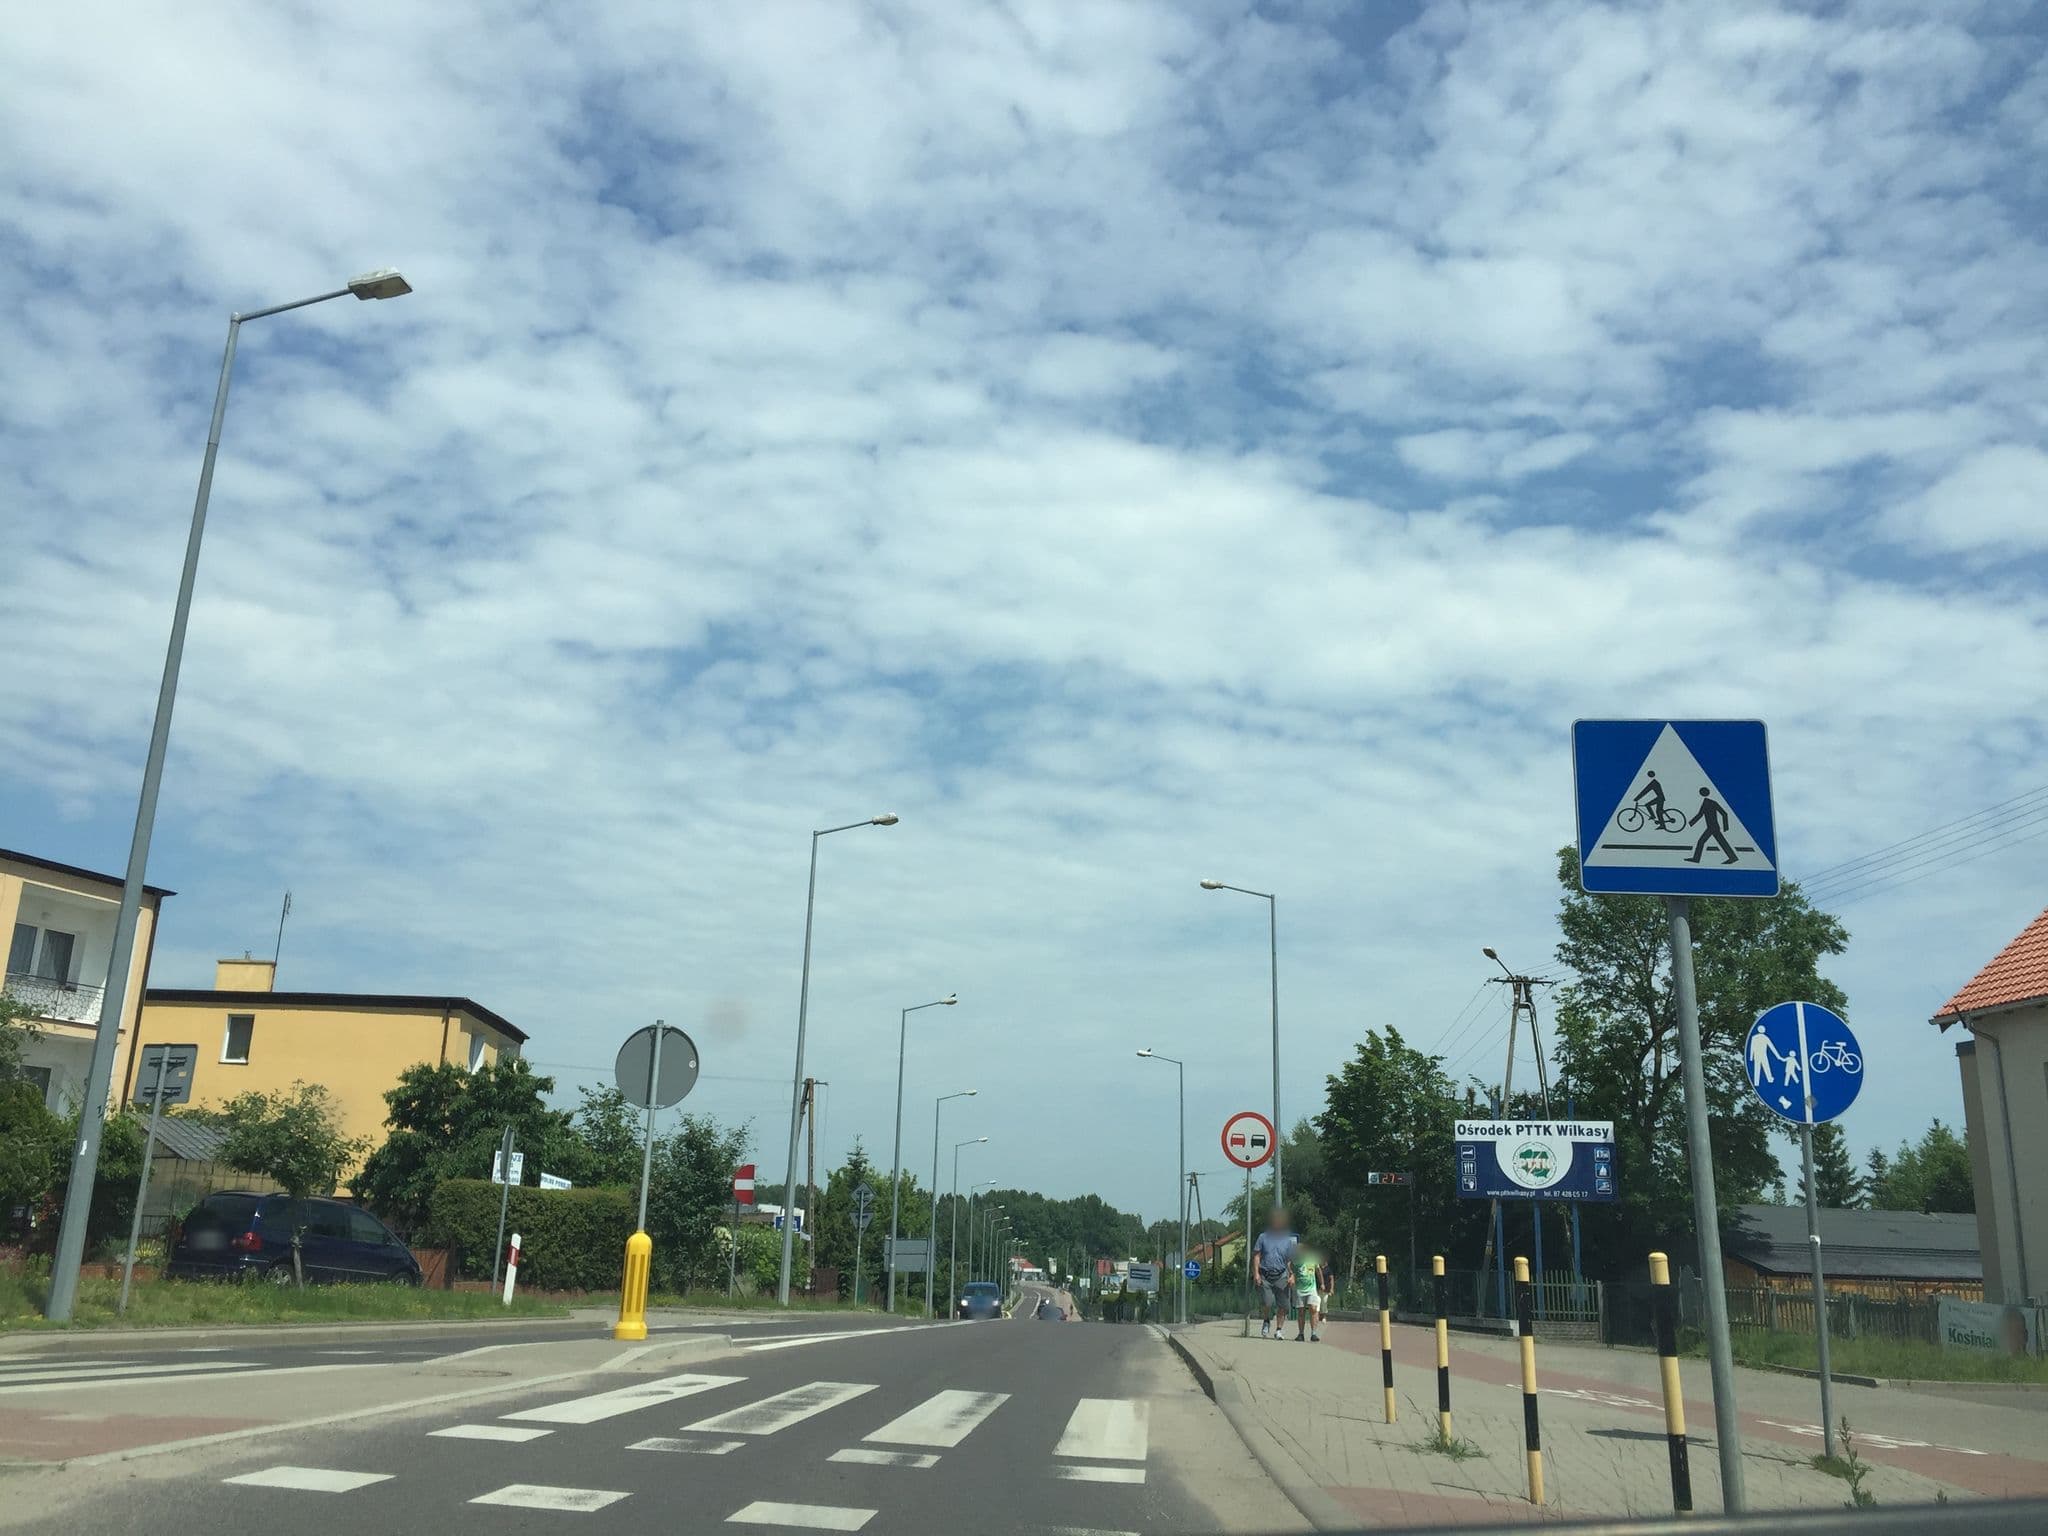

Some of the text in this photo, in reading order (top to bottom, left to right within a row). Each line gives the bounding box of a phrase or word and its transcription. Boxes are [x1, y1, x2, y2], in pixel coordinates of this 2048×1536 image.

[1457, 1123, 1609, 1138] Ośrodek PTTK Wilkasy
